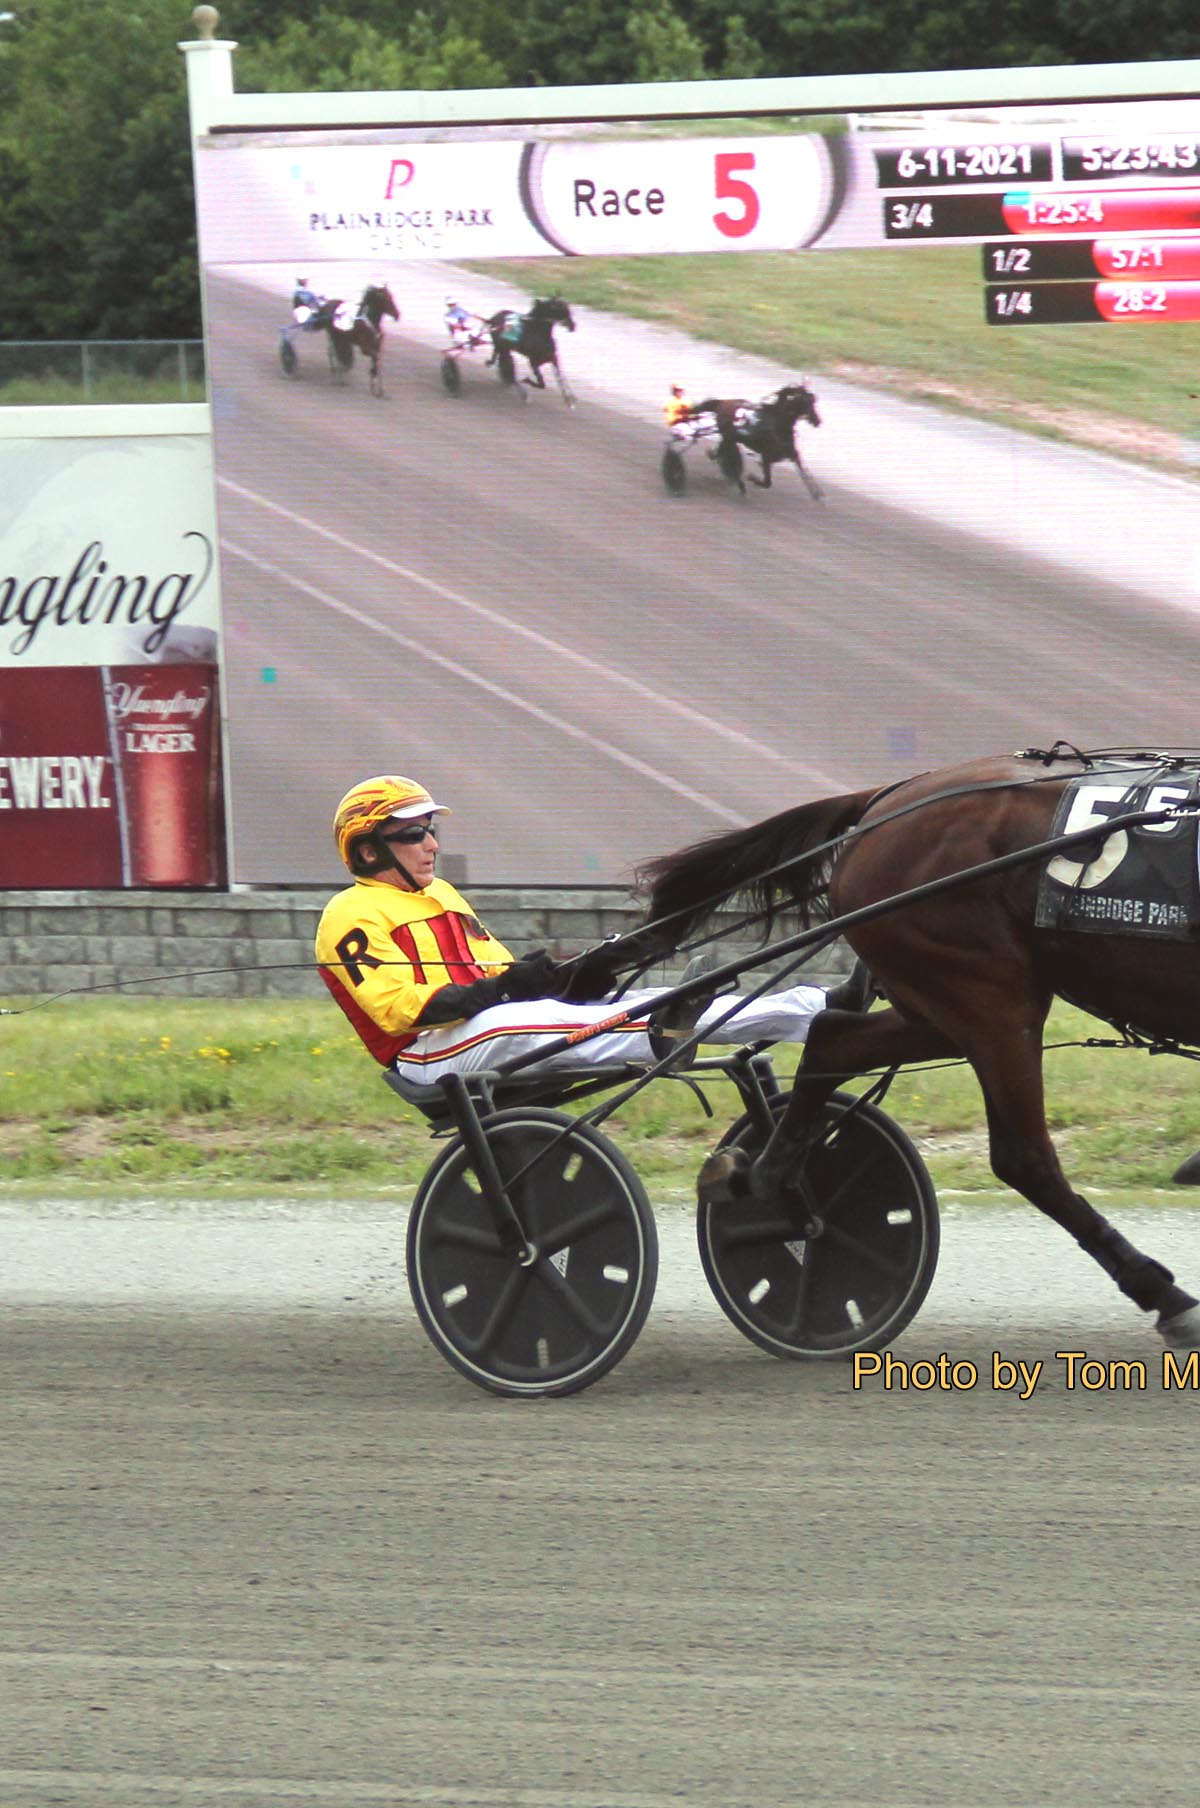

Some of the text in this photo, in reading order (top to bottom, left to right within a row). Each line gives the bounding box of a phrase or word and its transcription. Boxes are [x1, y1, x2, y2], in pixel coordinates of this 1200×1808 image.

[897, 143, 1198, 178] 6-11-2021 5:23:43
[385, 159, 414, 199] P
[574, 152, 760, 239] Race 5
[444, 208, 494, 227] PARK
[890, 199, 1104, 229] 3/4 1:25:4
[369, 231, 442, 250] CASNO
[991, 246, 1163, 272] 1/2 57:1
[994, 288, 1168, 316] 1/4 28:2
[126, 732, 197, 754] LAGER
[1046, 785, 1129, 889] 5
[334, 926, 385, 988] R
